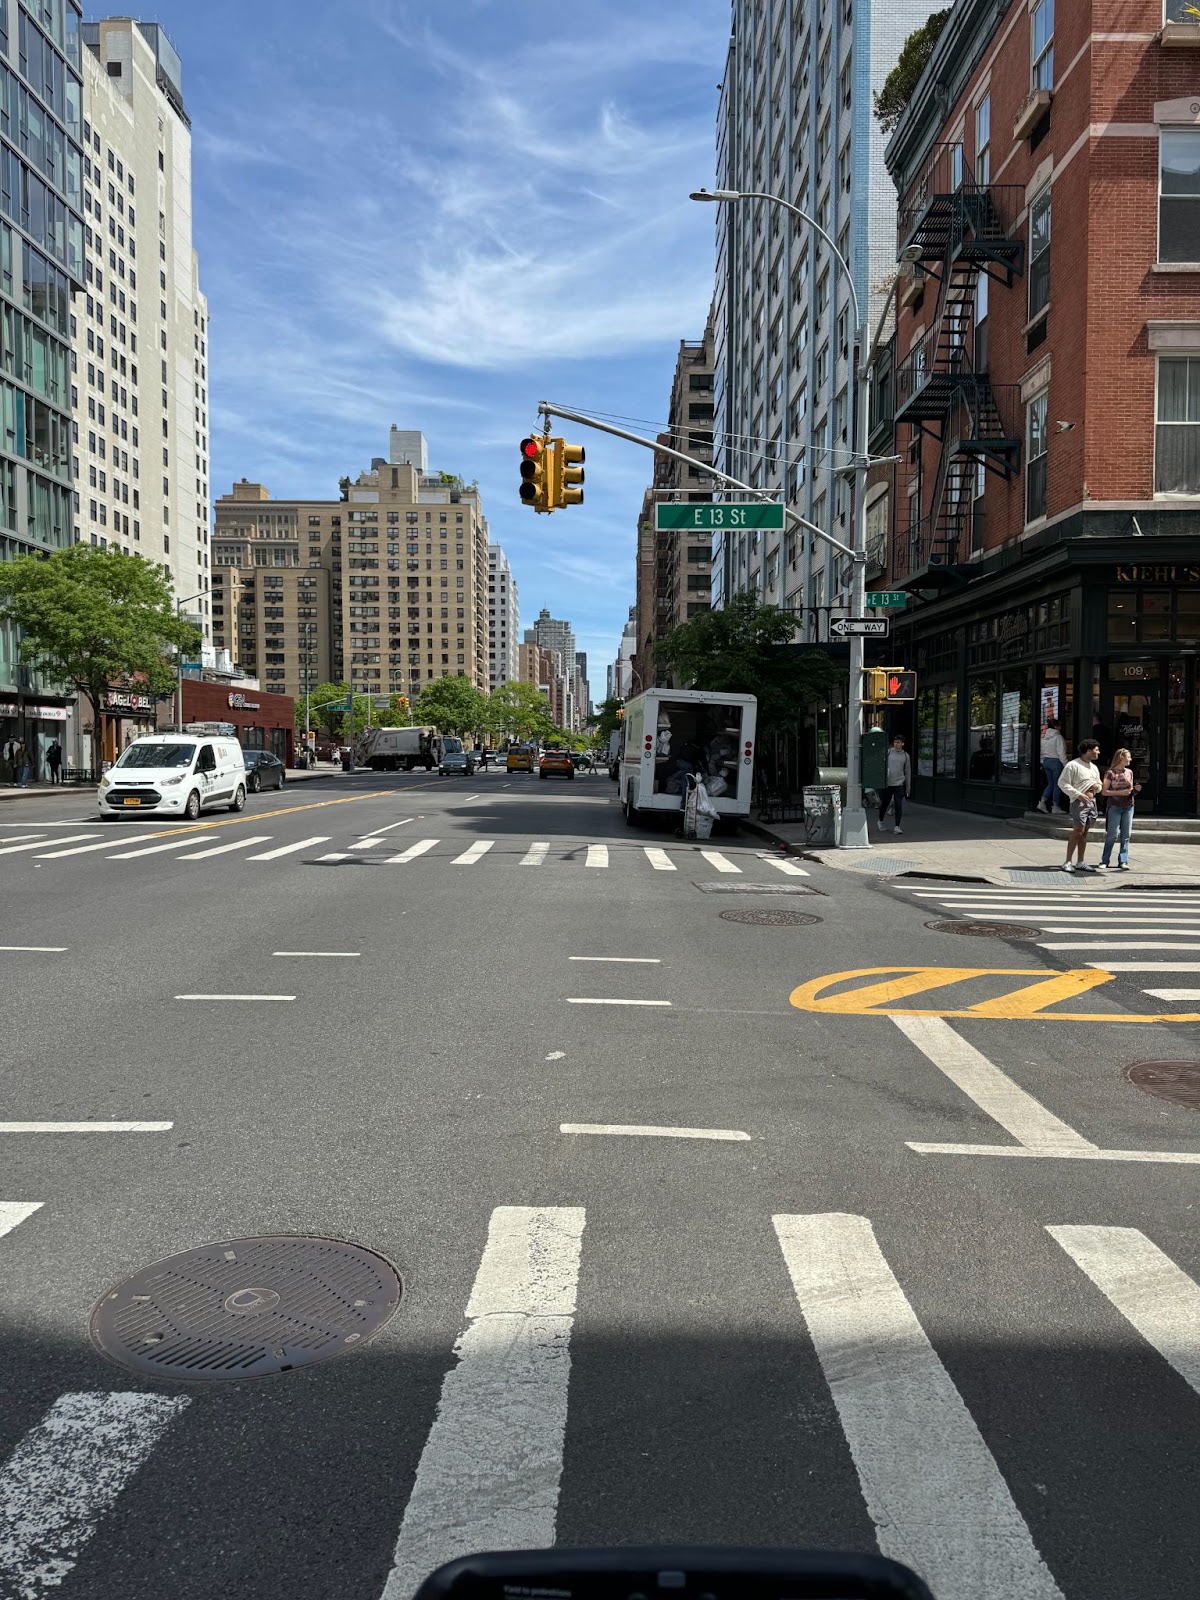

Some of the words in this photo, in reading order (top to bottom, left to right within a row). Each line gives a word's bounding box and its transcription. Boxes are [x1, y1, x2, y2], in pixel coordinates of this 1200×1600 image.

[694, 508, 703, 525] E
[710, 508, 724, 525] 13
[730, 508, 746, 525] St
[1116, 566, 1200, 582] KIEHL'S
[871, 593, 877, 605] E
[881, 593, 890, 605] 13
[837, 623, 855, 631] ONE
[864, 623, 883, 631] WAY
[1123, 666, 1144, 676] 109
